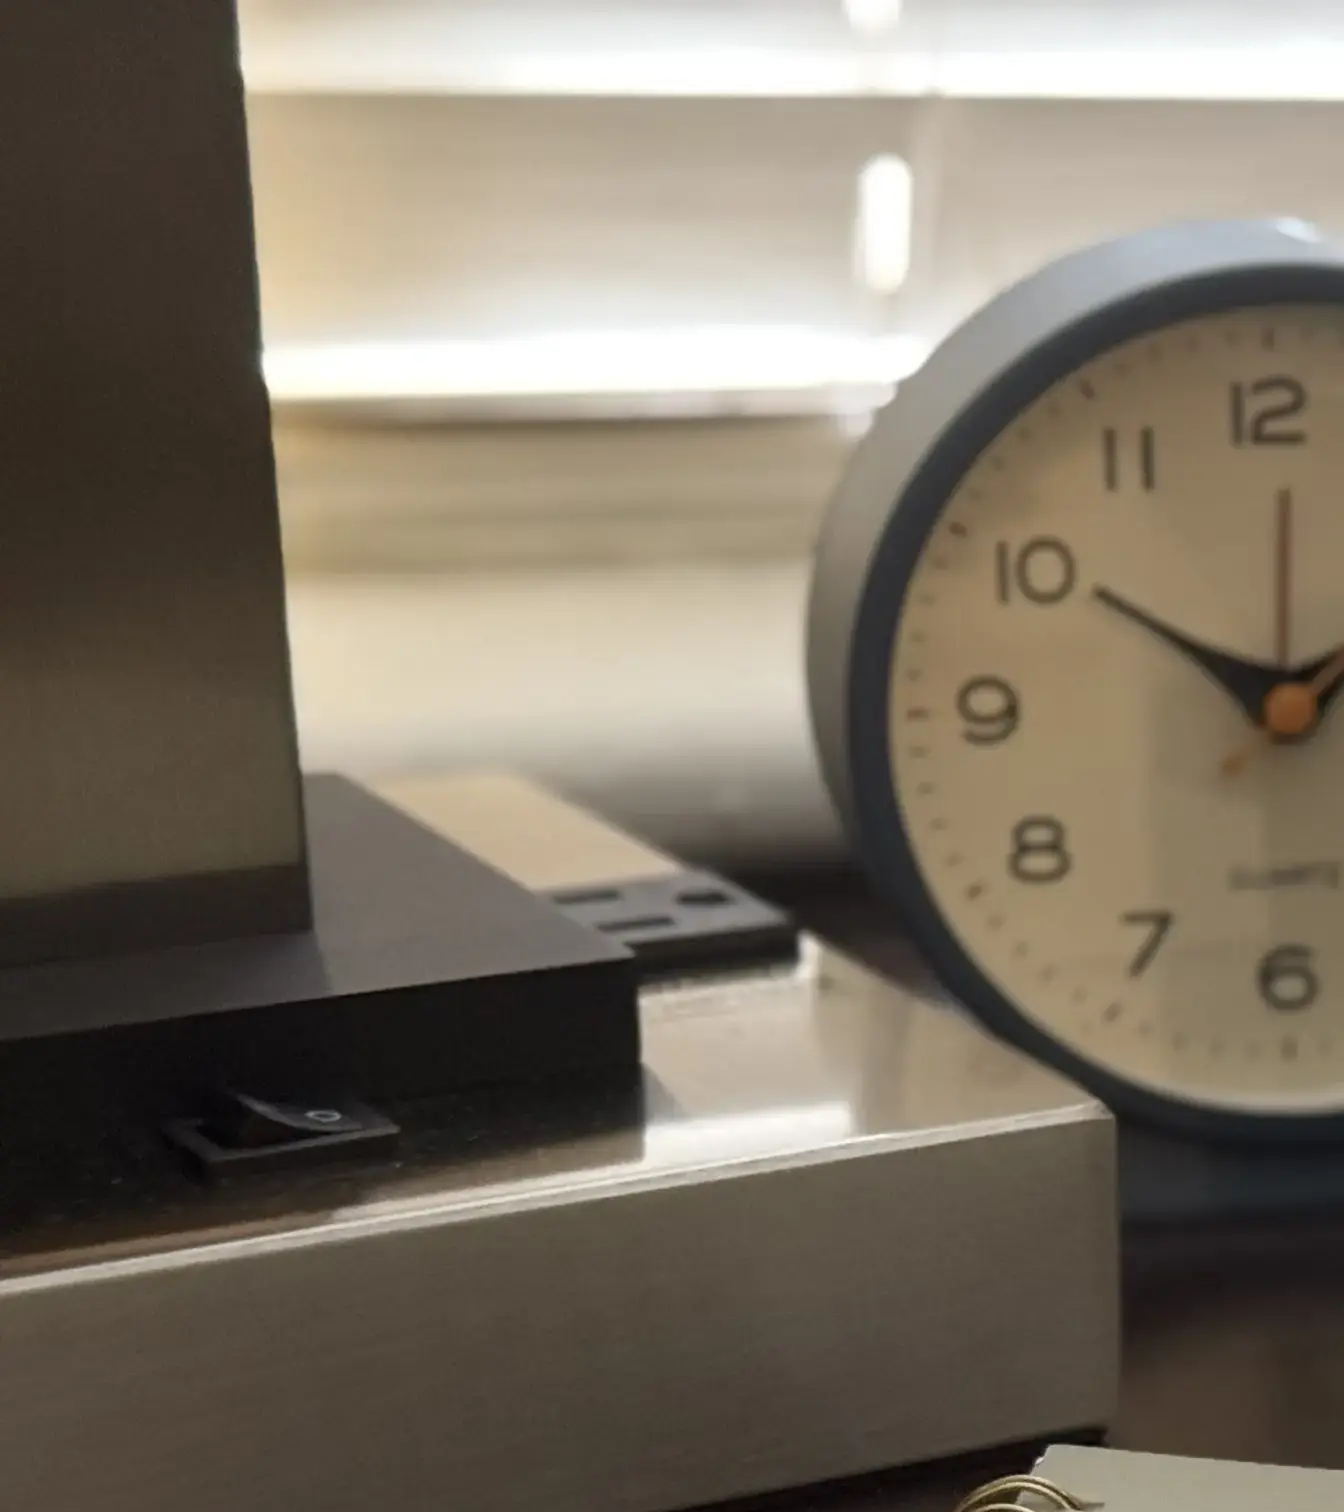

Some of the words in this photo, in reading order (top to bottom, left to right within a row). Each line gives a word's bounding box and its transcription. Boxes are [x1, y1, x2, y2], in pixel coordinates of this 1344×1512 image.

[1230, 376, 1308, 447] 12
[1102, 426, 1156, 491] 11
[996, 537, 1077, 606] 10
[956, 676, 1019, 744] 9
[1008, 815, 1073, 884] 8
[1121, 911, 1174, 977] 7
[1256, 945, 1319, 1010] 6
